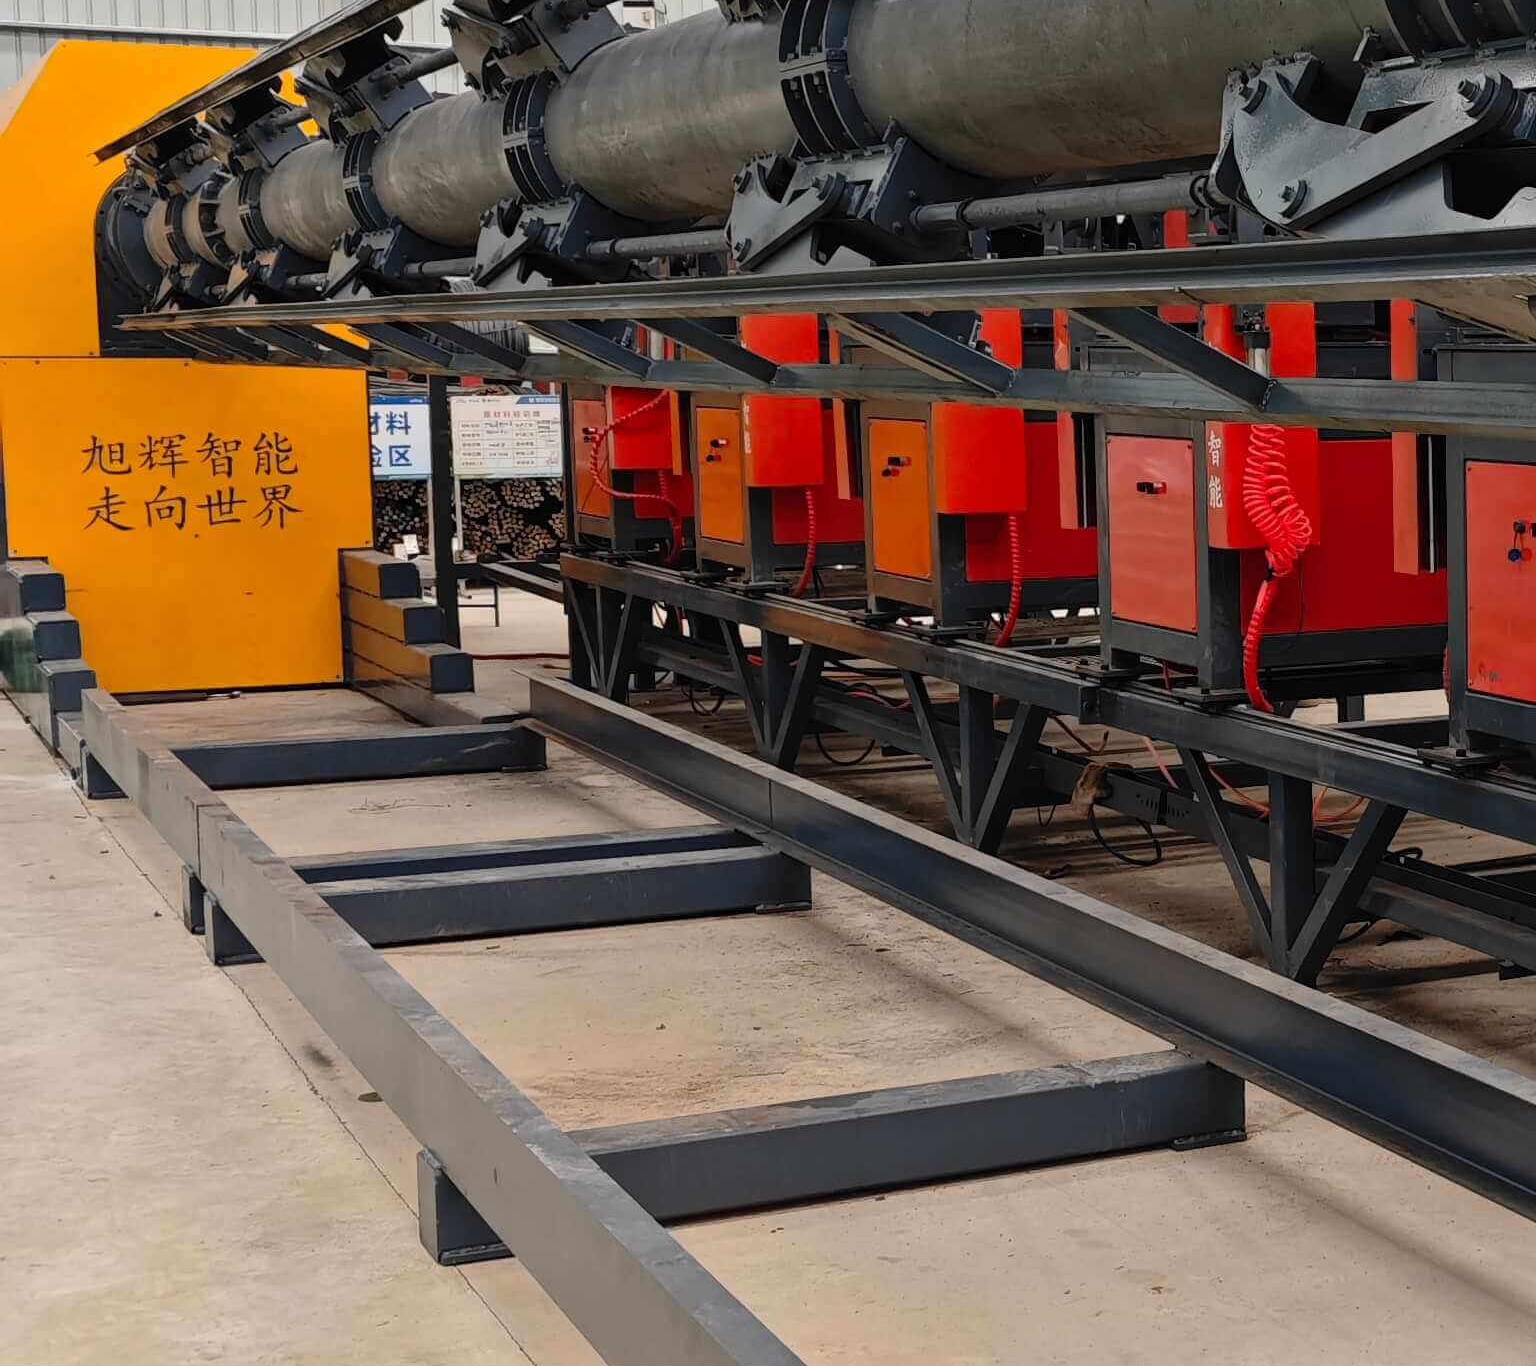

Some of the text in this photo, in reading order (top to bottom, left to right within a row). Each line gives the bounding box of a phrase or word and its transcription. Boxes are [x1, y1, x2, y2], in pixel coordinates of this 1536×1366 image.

[81, 431, 300, 479] 旭辉智能
[1207, 429, 1224, 508] 智能
[83, 483, 305, 532] 走向世界
